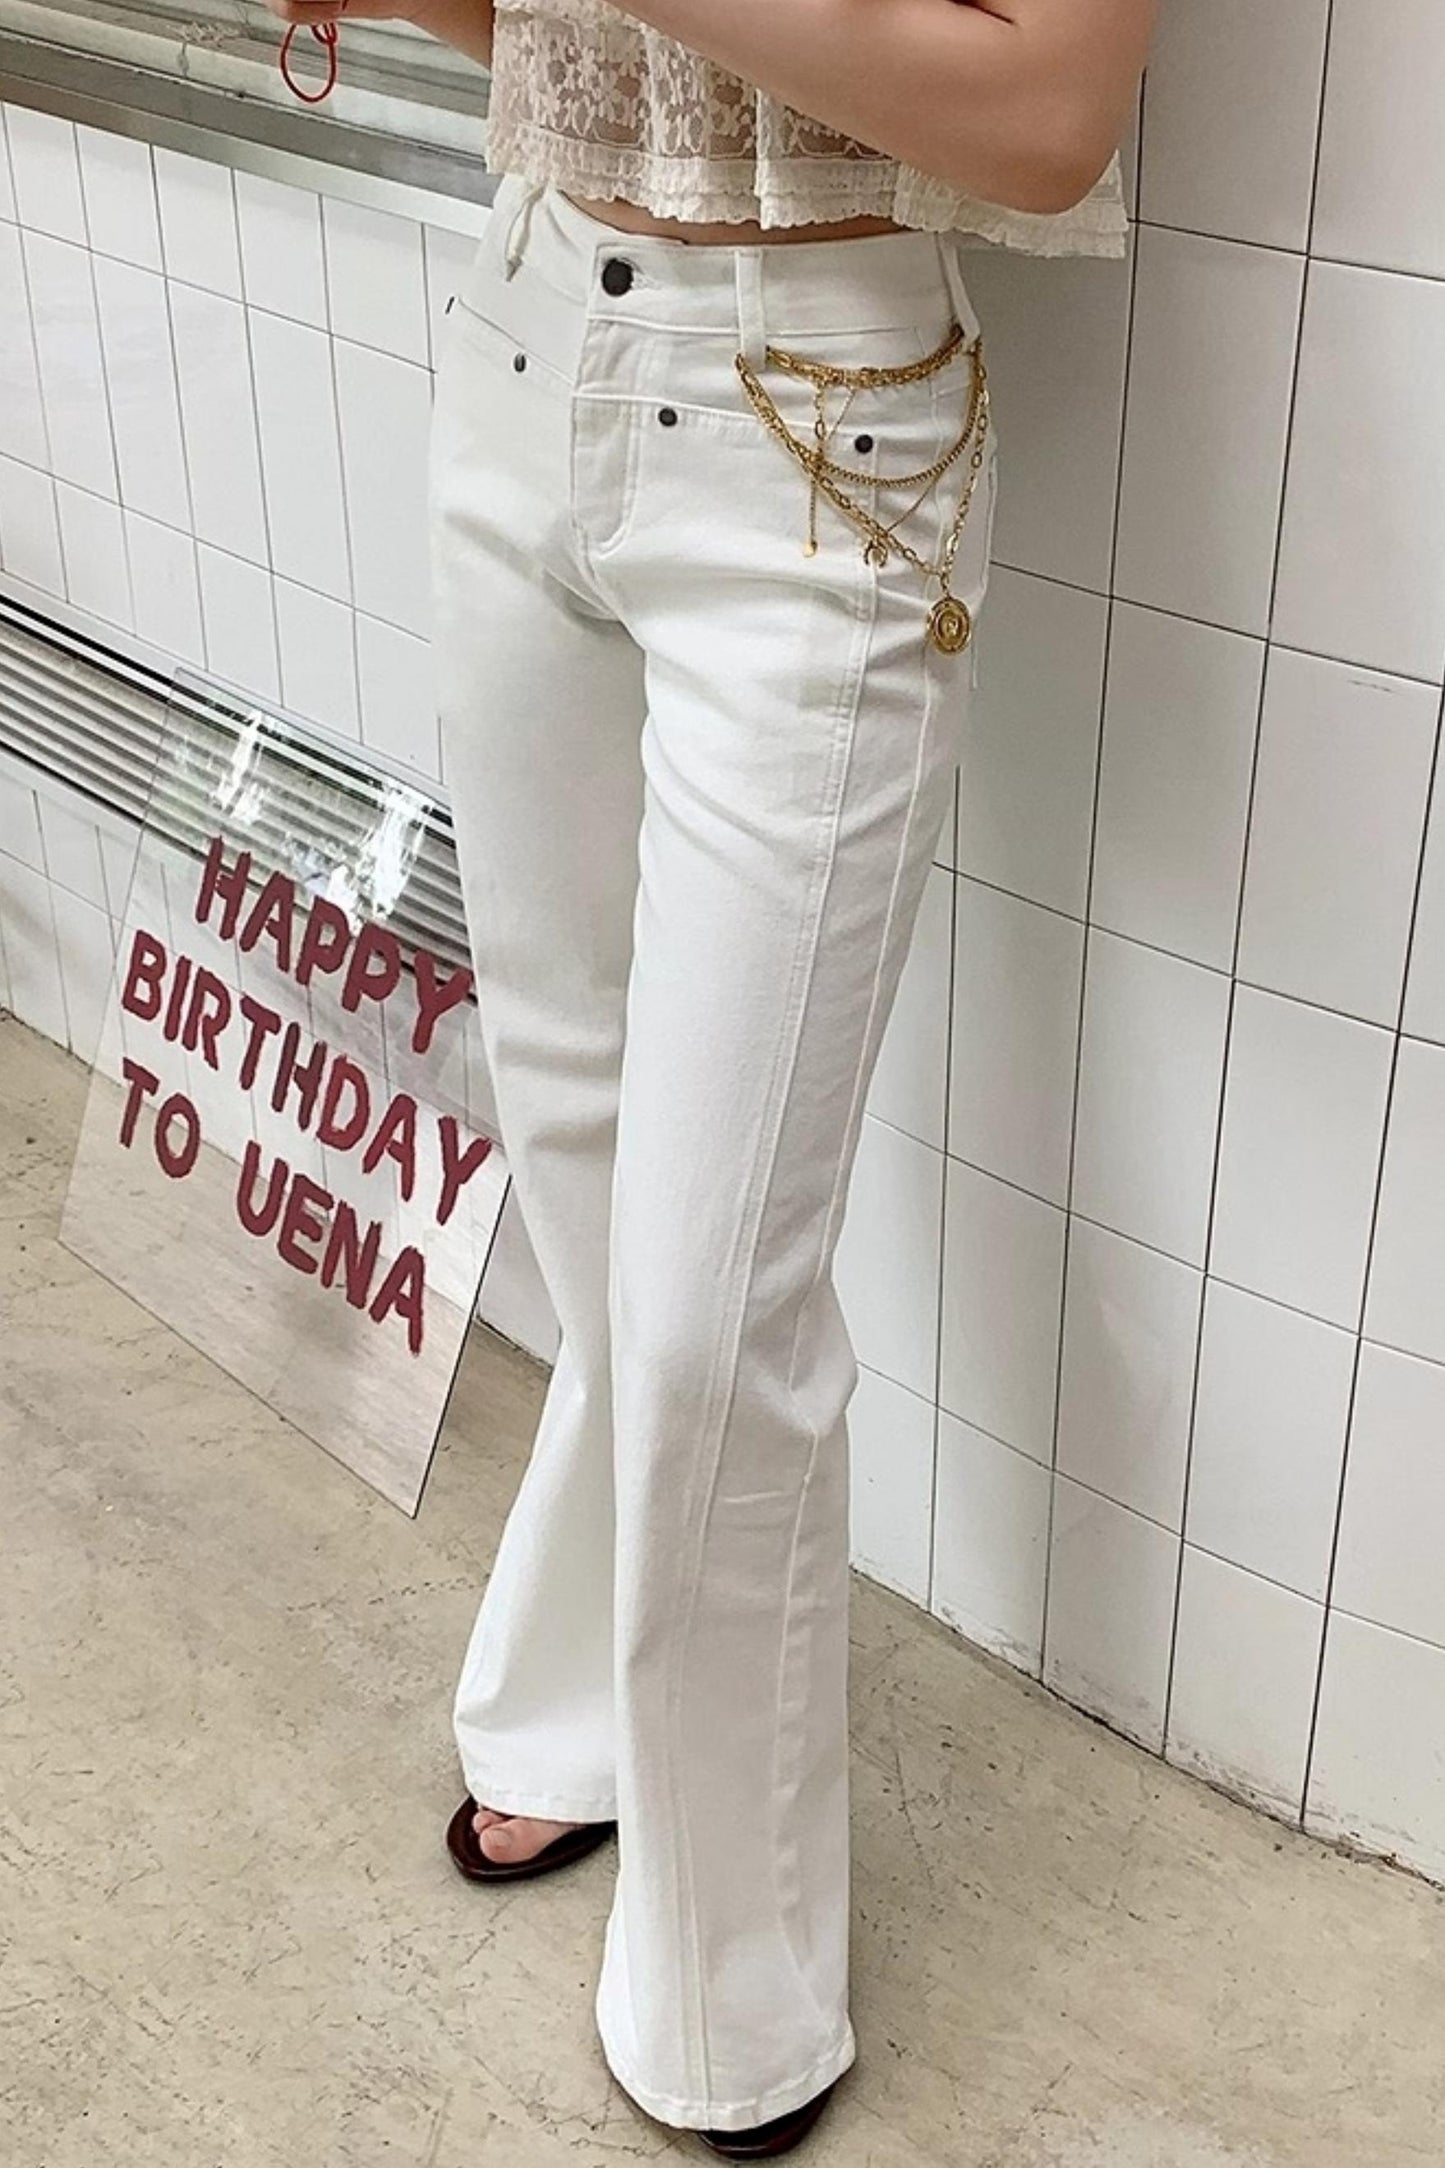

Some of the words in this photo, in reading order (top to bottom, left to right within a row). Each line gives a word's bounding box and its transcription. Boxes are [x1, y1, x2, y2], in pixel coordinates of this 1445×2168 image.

[121, 930, 492, 1225] BIRTHDAY
[195, 836, 475, 1054] HAPPY
[119, 1057, 202, 1179] TO
[236, 1140, 426, 1356] UENA
